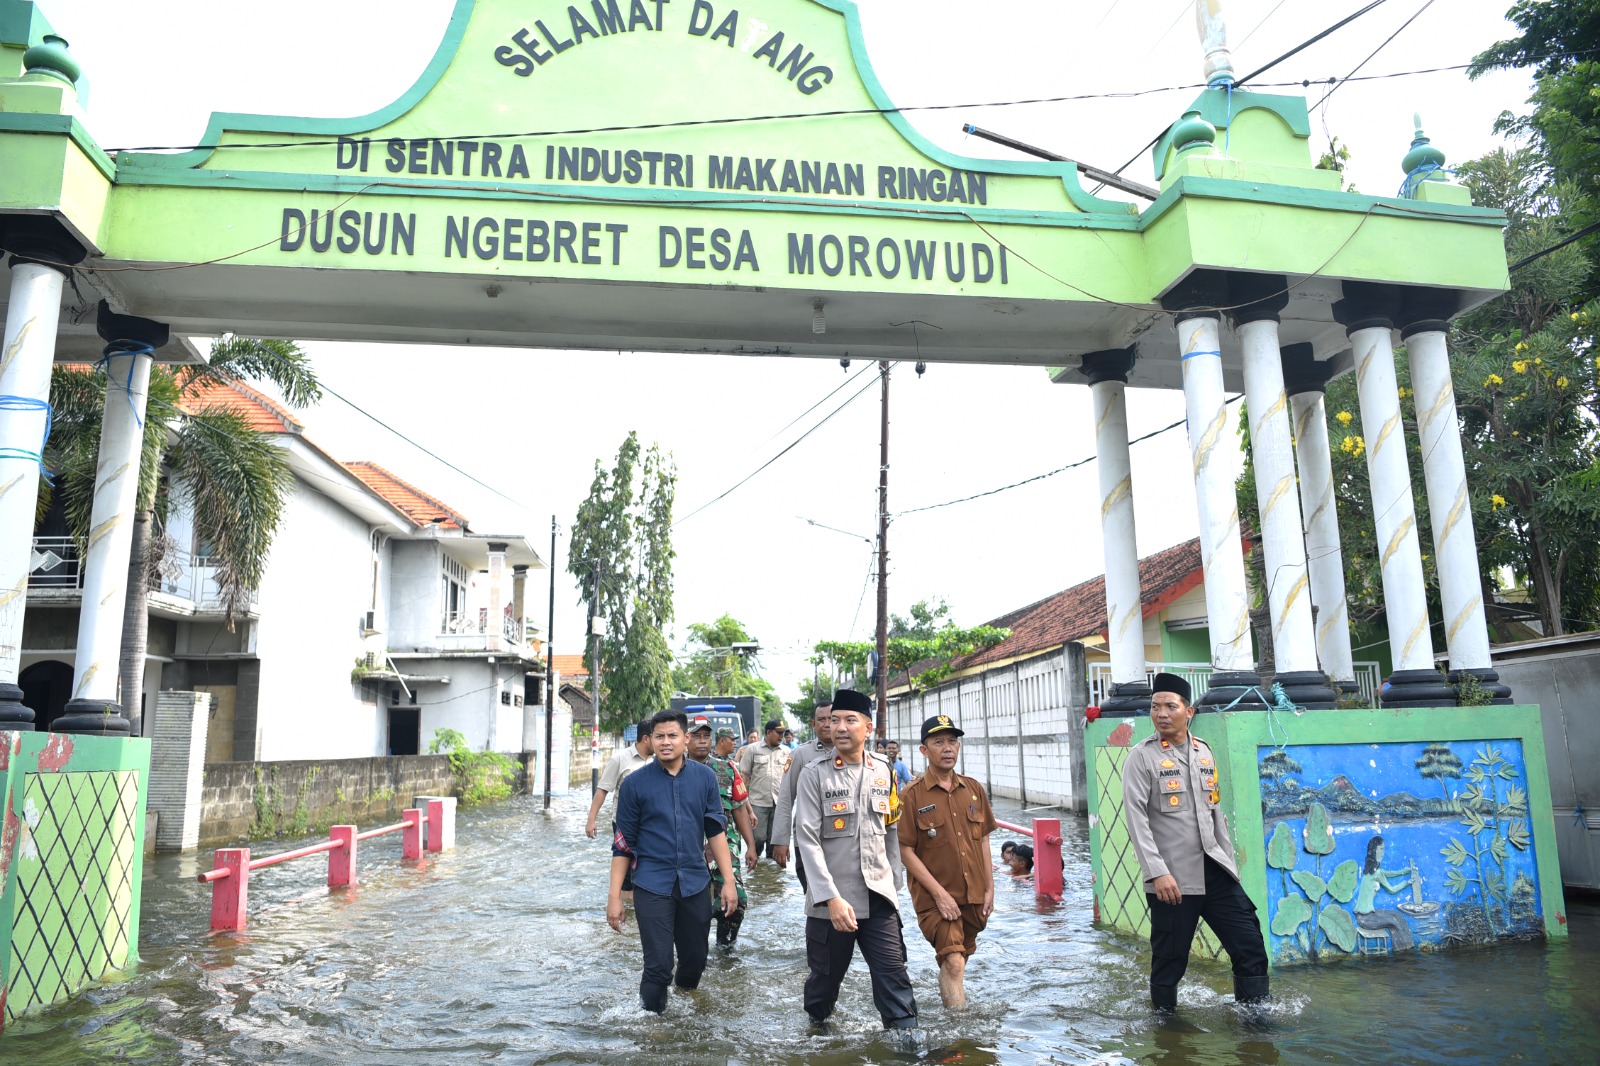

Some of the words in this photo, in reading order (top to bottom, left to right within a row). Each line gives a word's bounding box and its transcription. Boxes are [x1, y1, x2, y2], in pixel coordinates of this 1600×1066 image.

[494, 0, 670, 77] SELAMAT
[688, 0, 833, 95] DATANG
[337, 137, 370, 172] DI
[385, 137, 530, 179] SENTRA
[546, 145, 693, 187] INDUSTRI
[709, 155, 865, 196] MAKANAN
[878, 165, 987, 205] RINGAN
[280, 208, 416, 255] DUSUN
[445, 215, 628, 265] NGEBRET
[659, 225, 760, 272] DESA
[787, 232, 1009, 285] MOROWUDI
[825, 789, 849, 799] DANU
[1160, 769, 1181, 777] ANDIK
